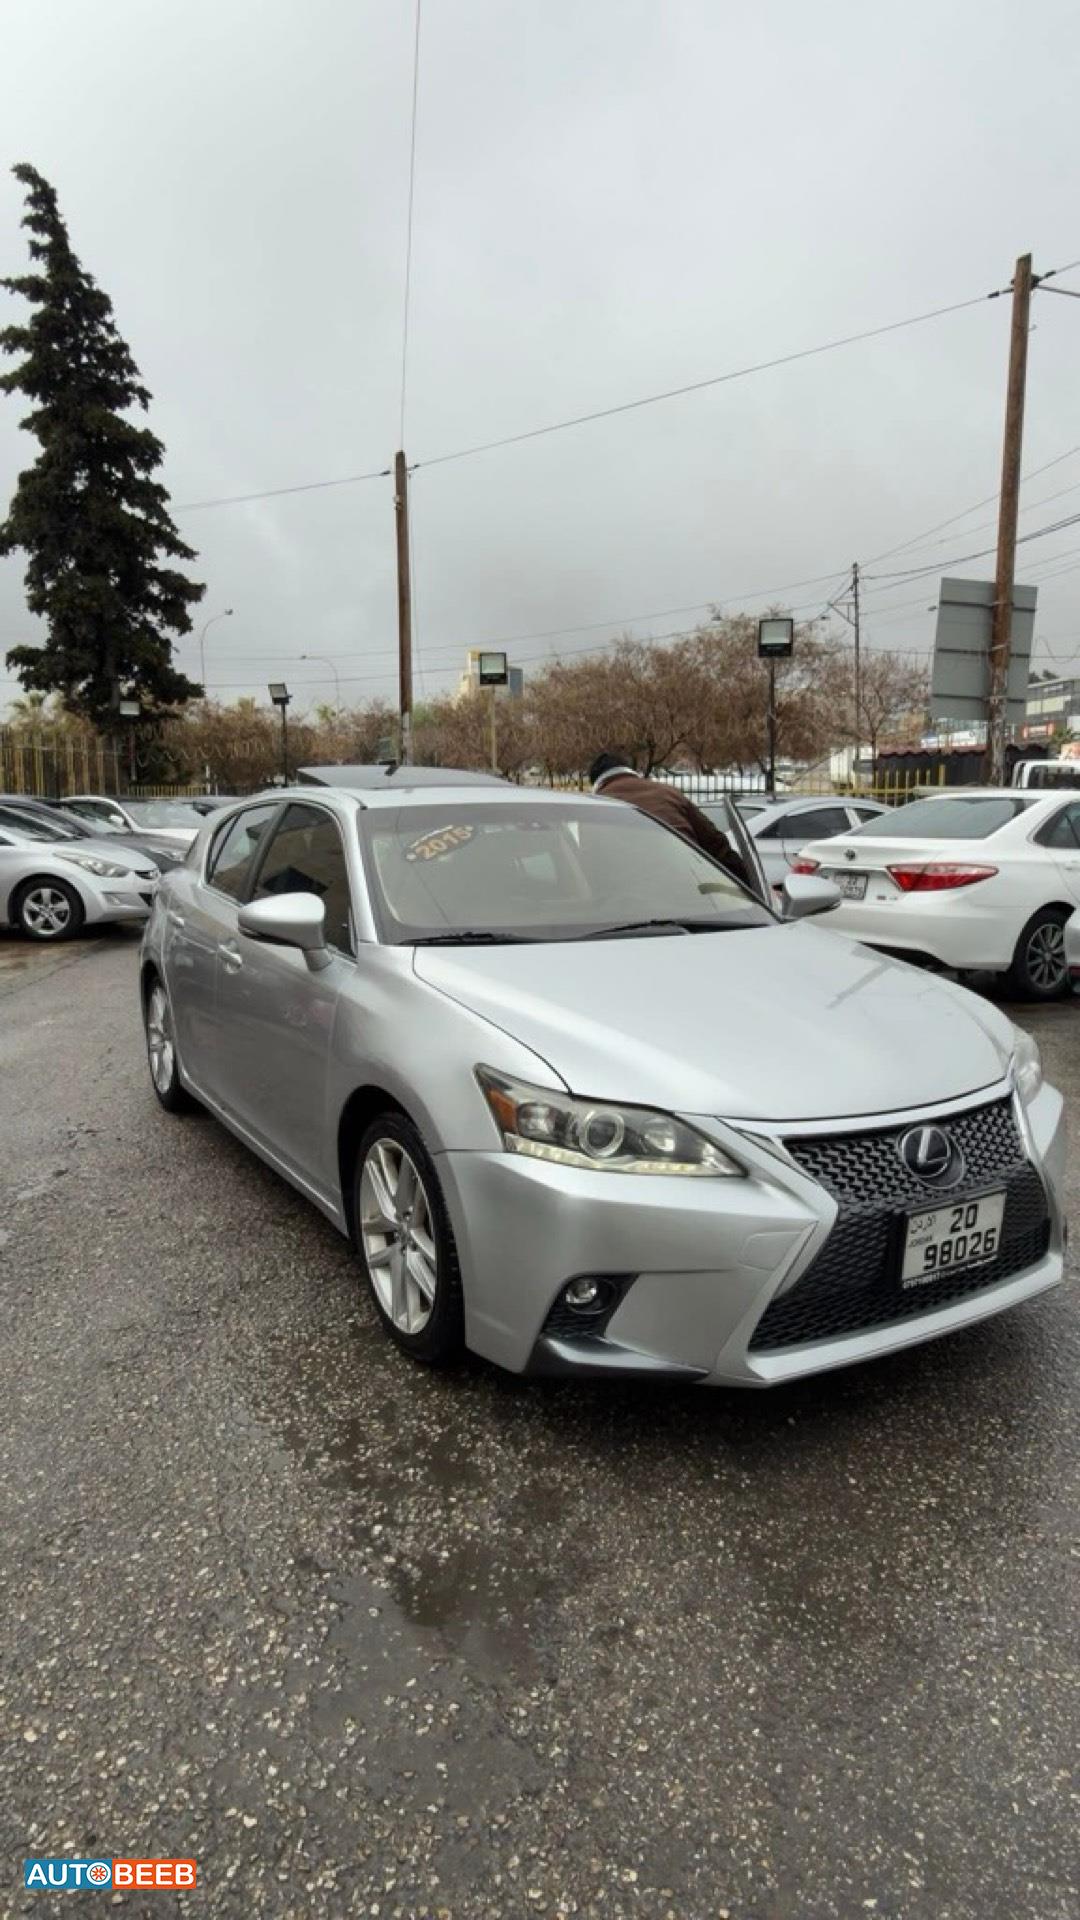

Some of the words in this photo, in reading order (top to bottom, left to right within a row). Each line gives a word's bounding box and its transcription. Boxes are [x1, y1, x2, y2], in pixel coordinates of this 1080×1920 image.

[415, 830, 472, 860] 2015
[949, 1203, 979, 1234] 20
[922, 1227, 997, 1271] 98026
